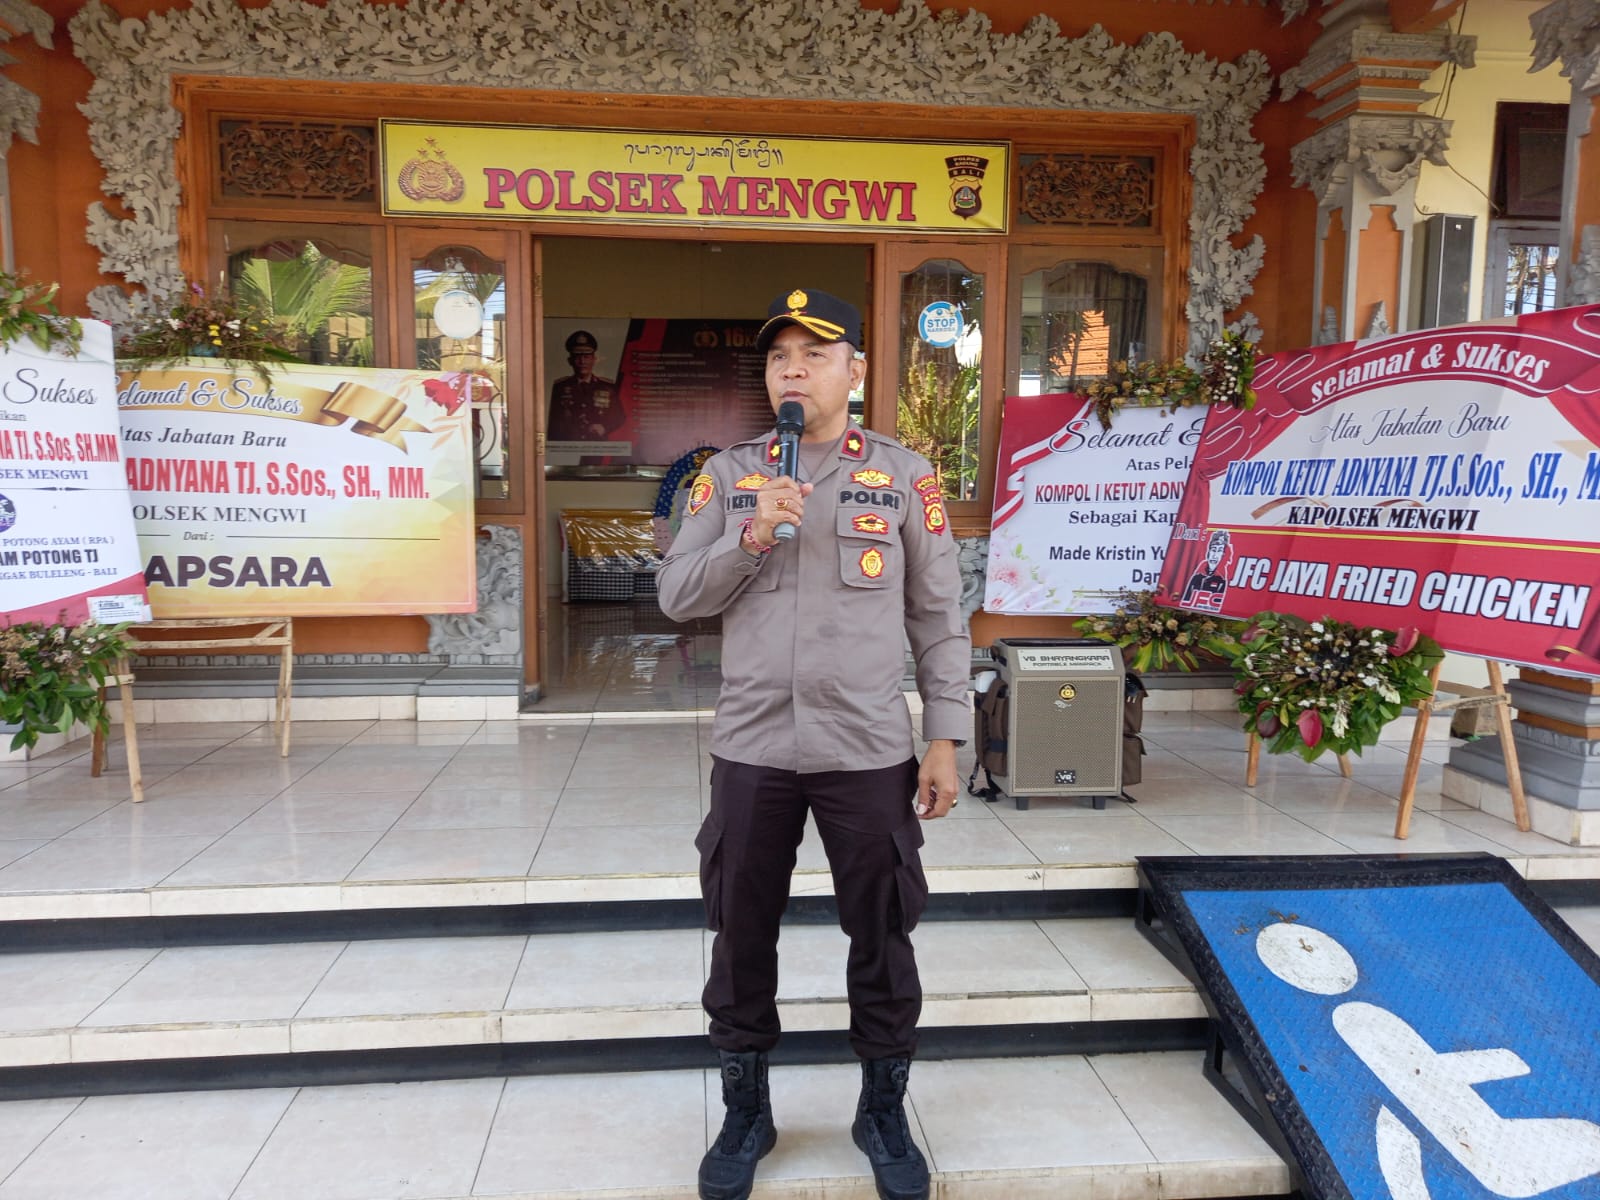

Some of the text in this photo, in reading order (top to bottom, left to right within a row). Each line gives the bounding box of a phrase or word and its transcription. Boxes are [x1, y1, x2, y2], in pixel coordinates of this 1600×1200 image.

[953, 169, 981, 177] BALI
[483, 168, 917, 222] POLSEK MENGWI
[927, 318, 956, 328] STOP
[1420, 343, 1445, 369] &
[3, 368, 97, 405] Sukses
[115, 377, 301, 414] elamat & Sukses
[1363, 406, 1443, 445] Jabatan
[1450, 402, 1511, 438] Baru
[158, 427, 235, 446] Jabatan
[241, 430, 288, 448] Baru
[1049, 419, 1174, 452] Selamat
[27, 469, 89, 480] MENGWI
[1125, 459, 1160, 471] Atas
[125, 458, 230, 494] ADNYANA
[235, 461, 261, 495] TJ.
[343, 465, 381, 500] SH.,
[388, 466, 430, 499] MM.
[1221, 460, 1283, 496] KOMPOL
[1280, 458, 1336, 496] KETUT
[1332, 455, 1418, 497] ADNYANA
[1522, 452, 1568, 505] SH.,
[840, 490, 900, 510] POLRI
[1035, 484, 1091, 503] KOMPOL
[1096, 483, 1100, 501] I
[1104, 482, 1146, 501] KETUT
[132, 505, 307, 523] OLSEK MENGWI
[1068, 510, 1137, 527] Sebagai
[1287, 505, 1480, 532] KAPOLSEK MENGWI
[3, 537, 49, 547] POTONG
[22, 549, 82, 566] POTONG
[1049, 546, 1091, 561] Made
[1096, 545, 1146, 561] Kristin
[93, 568, 118, 576] BALI
[146, 555, 332, 588] APSARA
[1229, 556, 1593, 630] JFC JAYA FRIED CHICKEN
